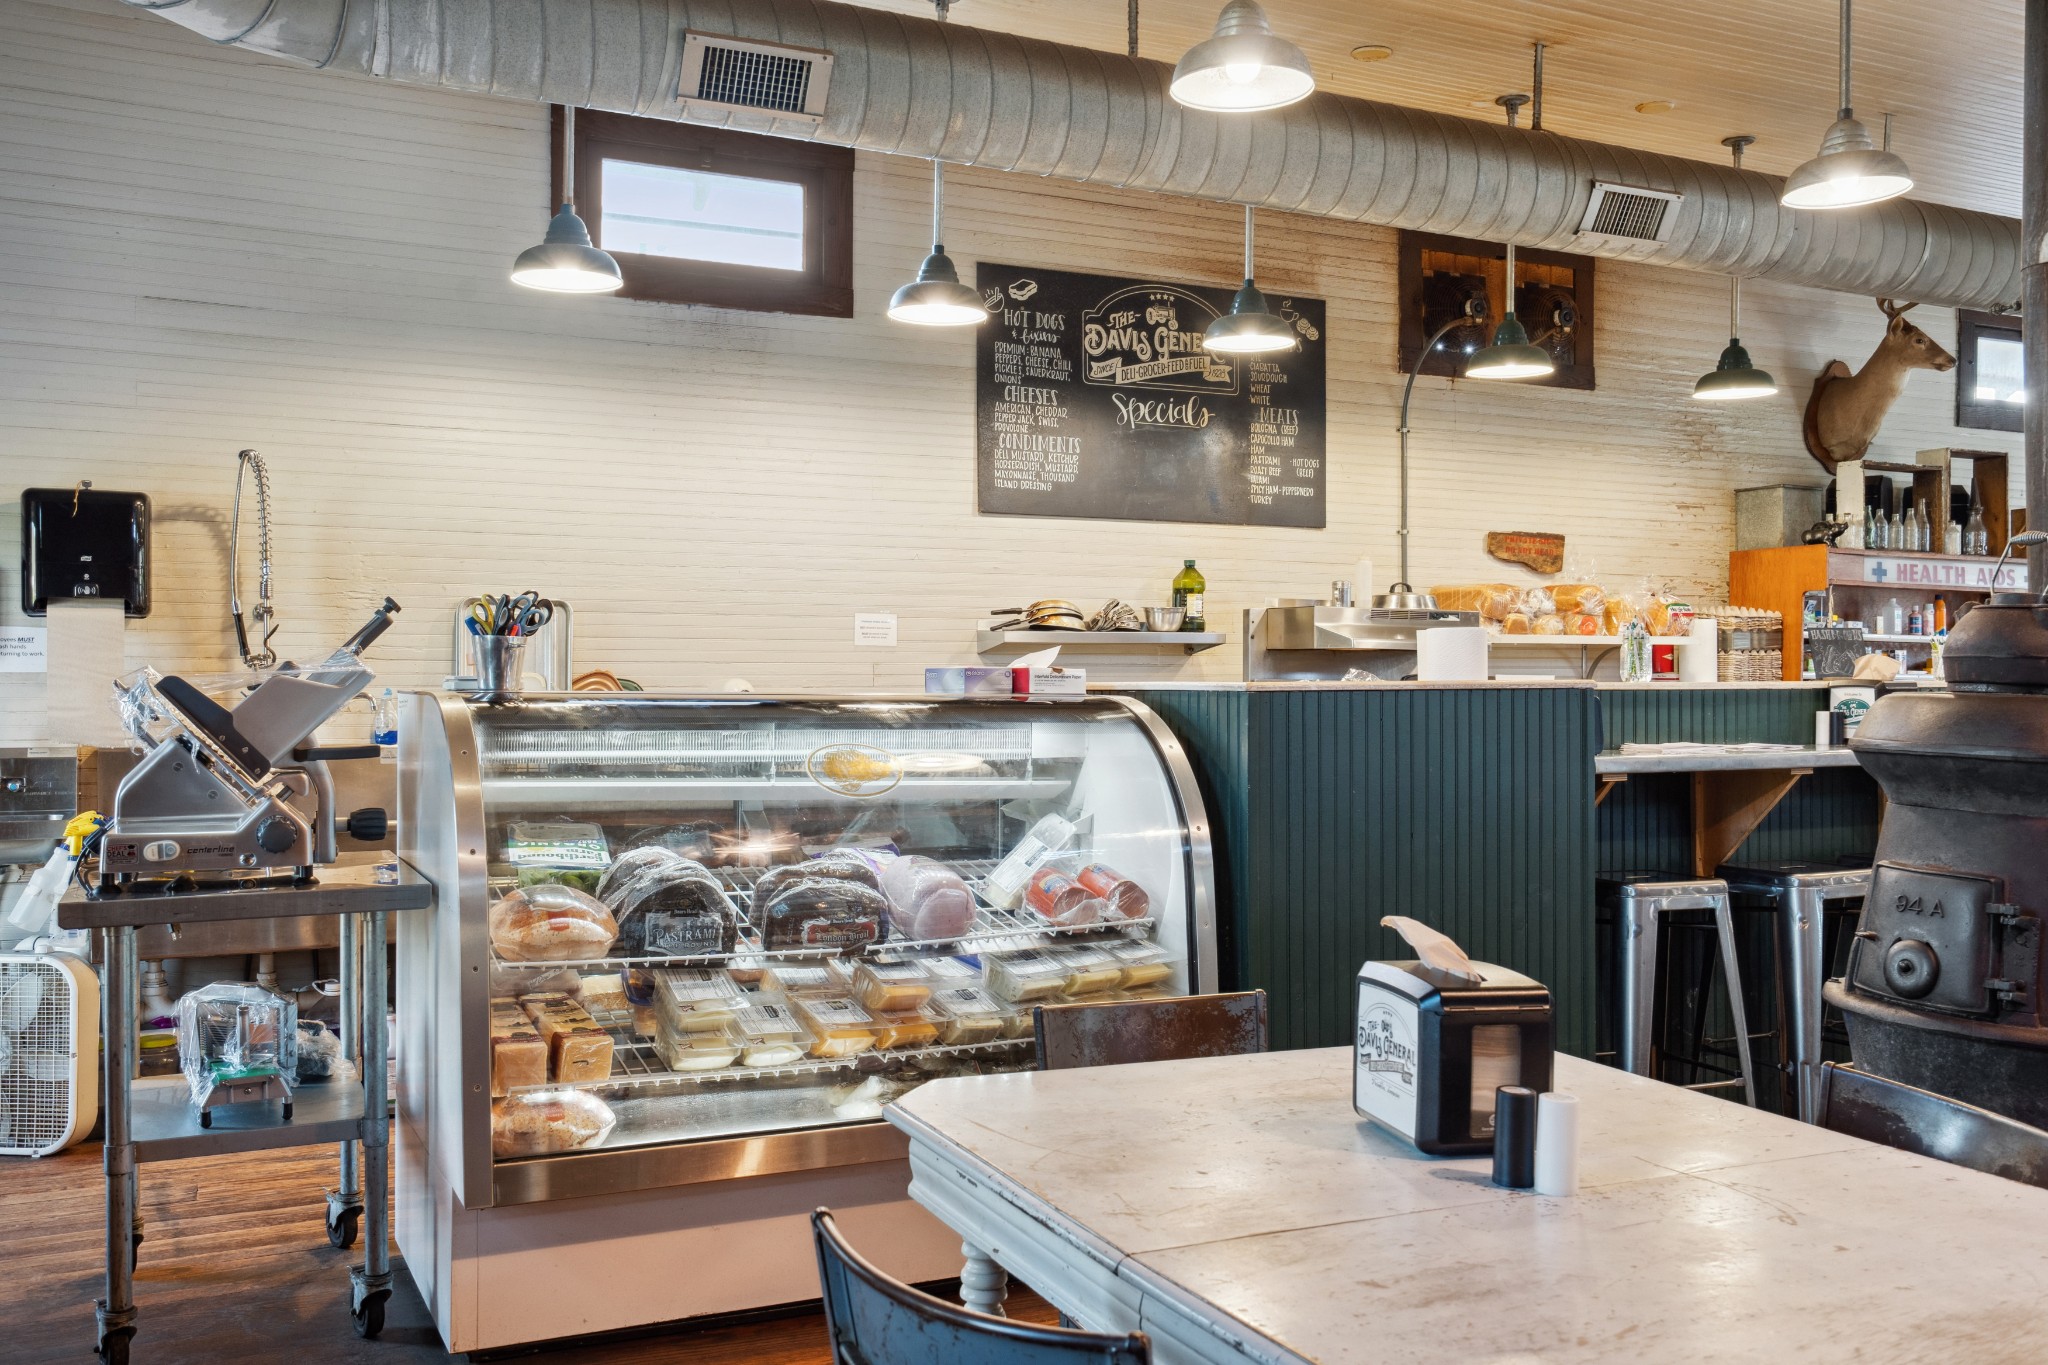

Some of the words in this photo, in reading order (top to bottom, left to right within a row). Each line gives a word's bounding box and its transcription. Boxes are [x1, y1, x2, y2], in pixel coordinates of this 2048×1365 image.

[1004, 308, 1031, 328] HOT
[1036, 312, 1066, 330] DOGS
[1107, 310, 1140, 329] THE
[1085, 324, 1152, 361] DAVIS
[1030, 345, 1062, 359] BANANA
[1189, 358, 1206, 370] FUEL
[1250, 362, 1280, 372] CIABATTA
[994, 373, 1021, 384] ONIONS
[1250, 372, 1287, 383] SOURDOUGH
[1250, 384, 1271, 393] WHEAT
[1004, 385, 1058, 406] CHEESES
[1250, 394, 1270, 405] WHITE
[1112, 393, 1215, 429] Specials
[1260, 407, 1299, 426] MEATS
[994, 413, 1016, 423] PEPPER
[994, 422, 1028, 433] PROVOLONE
[1250, 423, 1277, 434] BOLOGNA
[999, 433, 1081, 453] CONDIMENTS
[1281, 436, 1294, 447] HAM
[994, 449, 1008, 460] DELI
[1251, 445, 1265, 454] HAM
[1250, 455, 1280, 465] PASTRAMI
[1292, 458, 1303, 467] HOT
[1304, 459, 1320, 468] DOGS
[1040, 472, 1075, 482] THOUSAND
[1250, 466, 1267, 475] ROAST
[1269, 467, 1282, 477] BEEF
[994, 479, 1018, 489] ISLAND
[1021, 480, 1052, 491] DRESSING
[1250, 485, 1265, 494] SPICY
[1250, 495, 1272, 504] TURKEY
[1896, 564, 1966, 584] HEALTH
[1976, 568, 2016, 587] AIDS
[187, 845, 235, 854] centerline
[1896, 895, 1923, 915] 94
[1929, 899, 1944, 918] A
[653, 928, 716, 945] PASTRAMI
[1359, 1026, 1382, 1057] DAVIS
[1383, 1035, 1416, 1070] GENERAL
